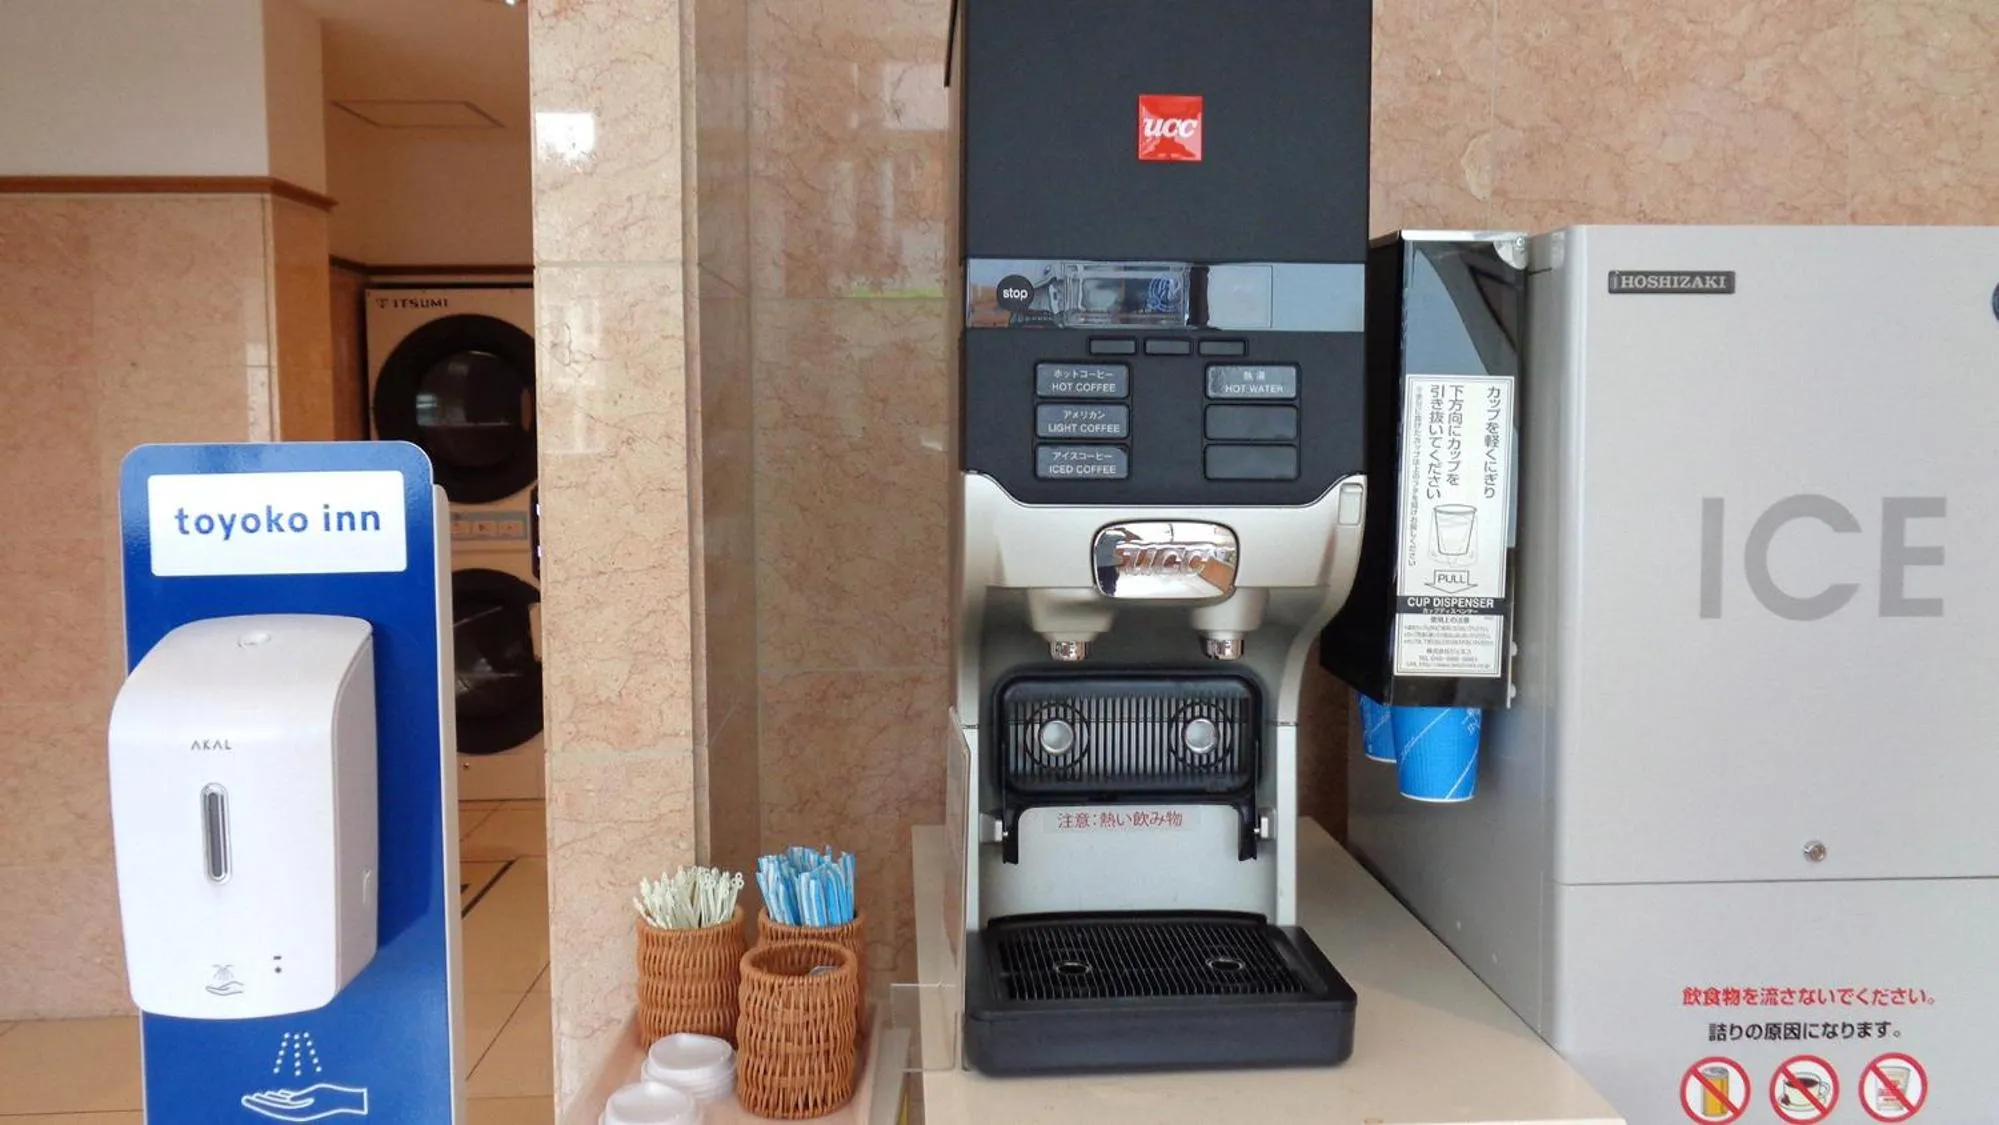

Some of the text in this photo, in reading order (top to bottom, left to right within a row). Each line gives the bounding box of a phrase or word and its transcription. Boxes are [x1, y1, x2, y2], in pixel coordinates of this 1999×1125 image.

[1620, 275, 1727, 289] HOSHIZAKI
[1002, 286, 1028, 301] stop
[1053, 369, 1114, 380] ホットコーヒー
[1051, 382, 1117, 393] HOT COFFEE
[1225, 384, 1283, 393] HOT WATER
[1063, 410, 1106, 420] アメリカン
[1048, 423, 1120, 433] LIGHT COFFEE
[1446, 384, 1464, 486] 下方向にカップを
[1426, 384, 1446, 500] 引き抜いてください
[1052, 451, 1113, 461] アイスコーヒー
[1049, 464, 1117, 474] ICED COFFEE
[174, 503, 381, 541] toyoko inn
[1699, 494, 1947, 621] ICE
[1437, 573, 1467, 584] PULL
[1407, 596, 1494, 609] CUP DISPENSER
[191, 739, 232, 750] AKAL
[1682, 986, 1936, 1007] 飲食物を流さないでください。
[1708, 1021, 1901, 1042] 詰りの原因になります。
